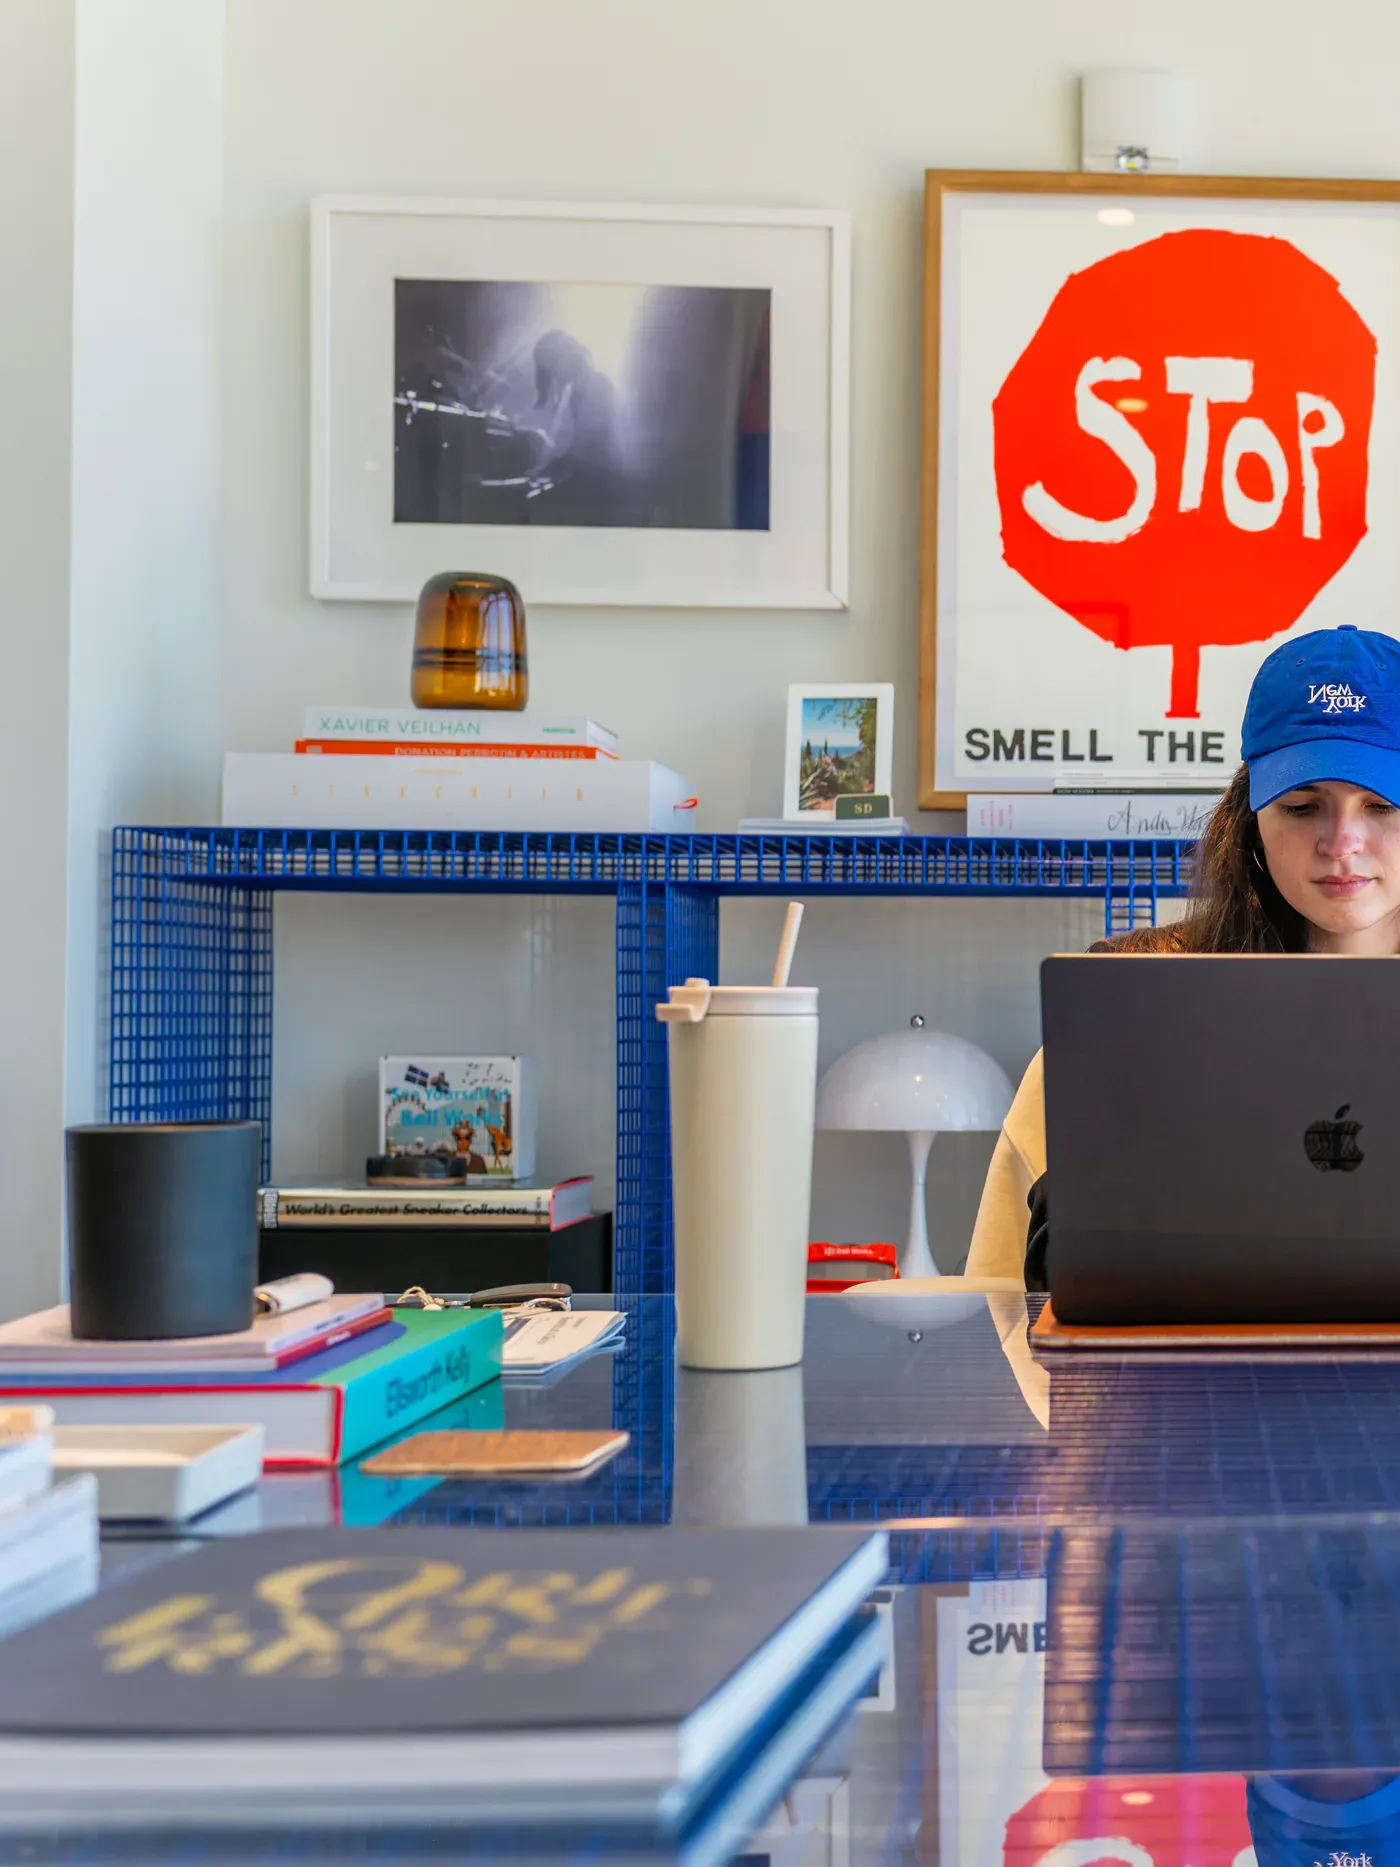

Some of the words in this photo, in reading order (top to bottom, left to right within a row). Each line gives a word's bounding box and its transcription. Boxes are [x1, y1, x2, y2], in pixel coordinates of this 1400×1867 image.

[1022, 356, 1345, 543] STOP
[319, 717, 390, 733] XAVIER
[397, 719, 482, 735] VEILHAN
[964, 728, 1113, 761] SMELL
[1138, 730, 1225, 762] THE
[1106, 800, 1179, 836] Andy
[401, 1109, 439, 1127] Bell
[443, 1108, 504, 1127] Works
[285, 1203, 334, 1216] World's
[339, 1204, 399, 1216] Greatest
[403, 1204, 460, 1216] Sneaker
[463, 1204, 528, 1216] Collectors
[385, 1360, 443, 1419] Ellsworth
[446, 1344, 470, 1384] Kelly
